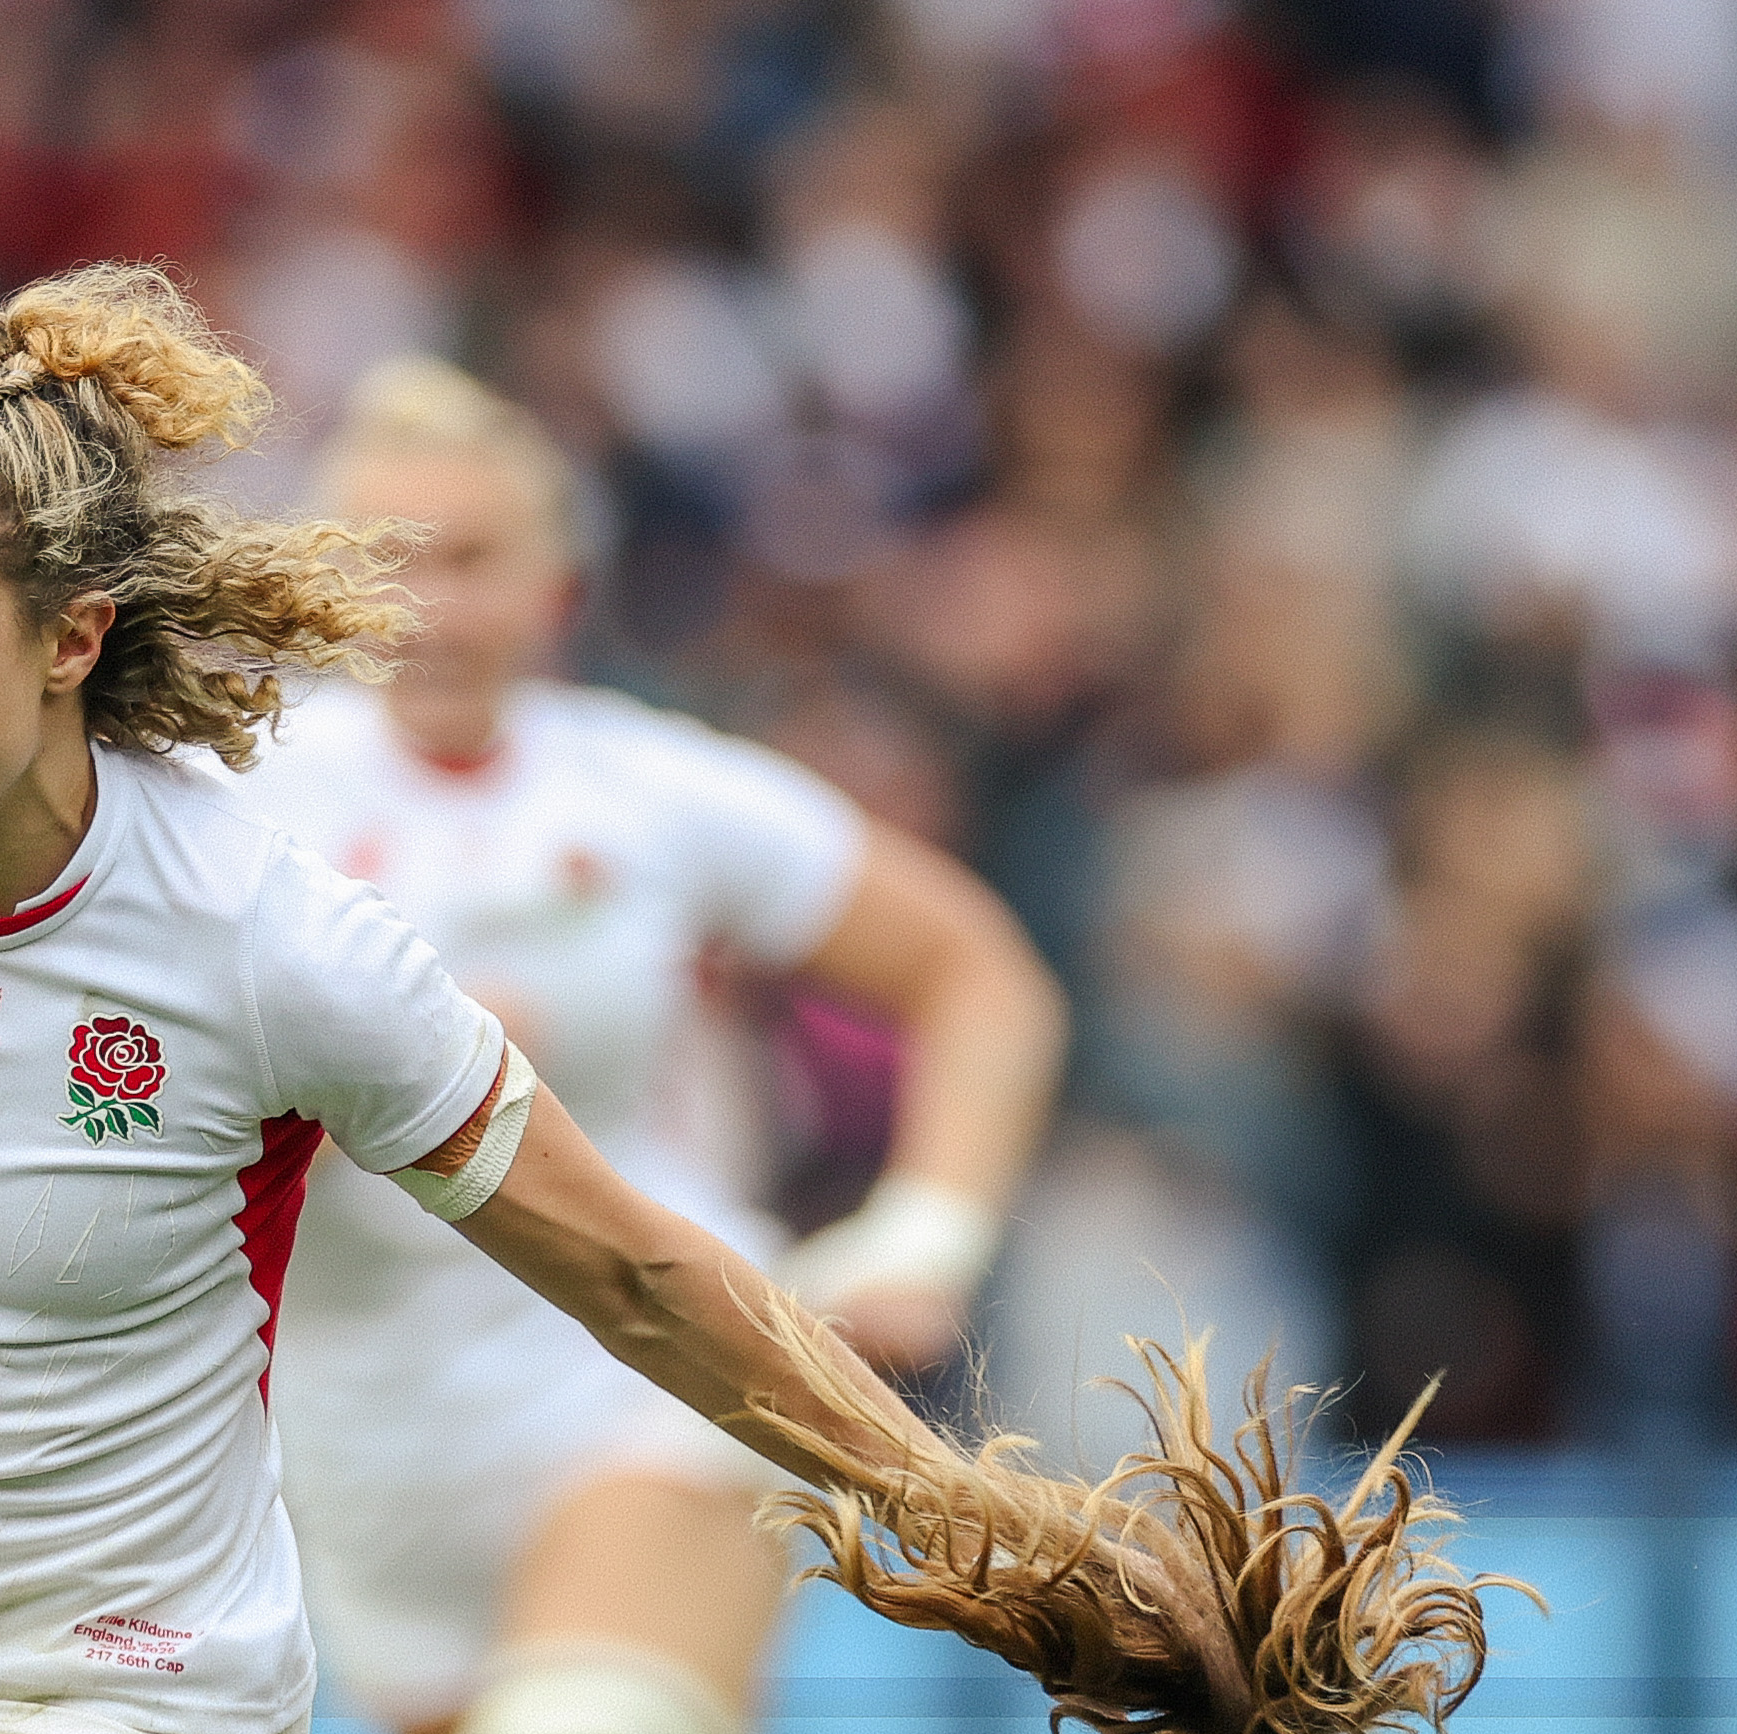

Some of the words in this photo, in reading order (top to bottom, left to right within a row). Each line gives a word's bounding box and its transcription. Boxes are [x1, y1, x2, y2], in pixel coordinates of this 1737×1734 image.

[74, 1624, 134, 1645] England
[85, 1648, 112, 1662] 217
[117, 1653, 150, 1669] 56th
[155, 1658, 185, 1675] Cap
